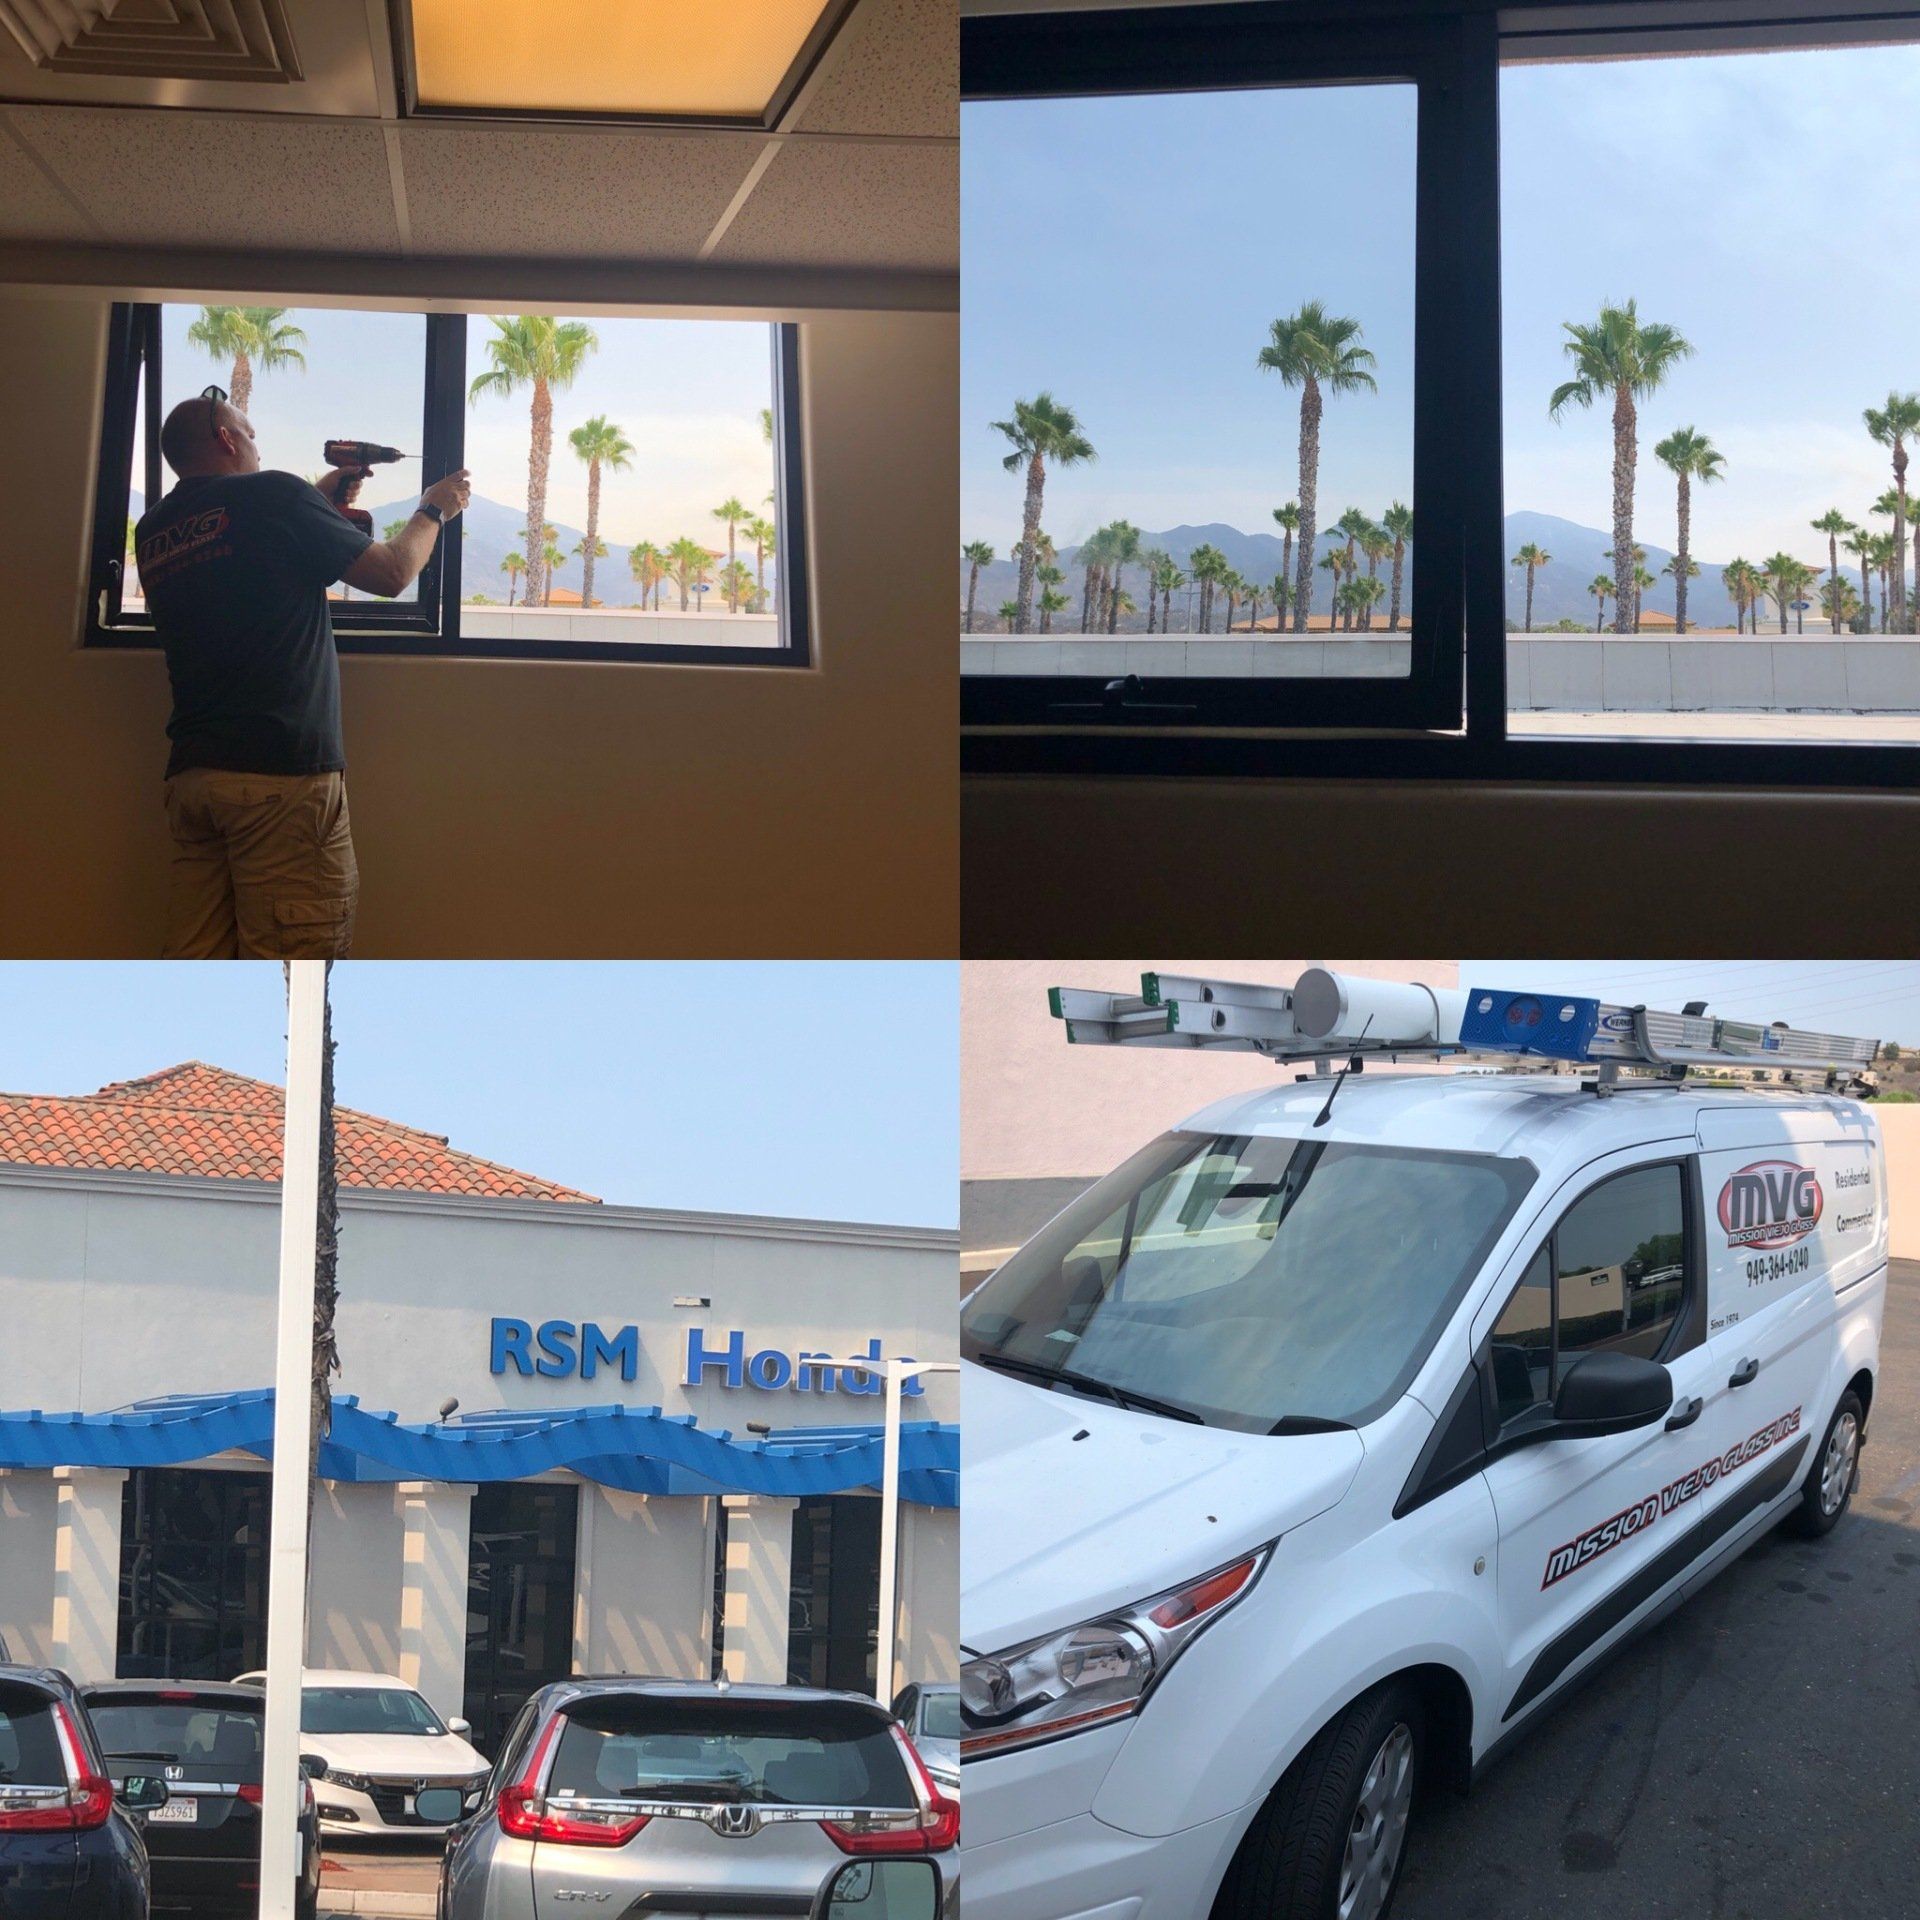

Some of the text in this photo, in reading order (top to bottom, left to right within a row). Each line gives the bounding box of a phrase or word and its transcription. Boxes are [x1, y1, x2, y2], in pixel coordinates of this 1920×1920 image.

[1835, 1167, 1870, 1189] Residential
[1729, 1168, 1816, 1231] MVG
[1728, 1220, 1814, 1245] MISSION VIEJO GLASS
[1836, 1208, 1873, 1232] Commercial
[1746, 1247, 1809, 1288] 949-364-6240
[490, 1317, 639, 1381] RSM
[1543, 1497, 1659, 1587] MISSION
[1662, 1462, 1721, 1512] VIEJO
[1721, 1429, 1773, 1474] GLASS
[553, 1889, 612, 1902] CR-V
